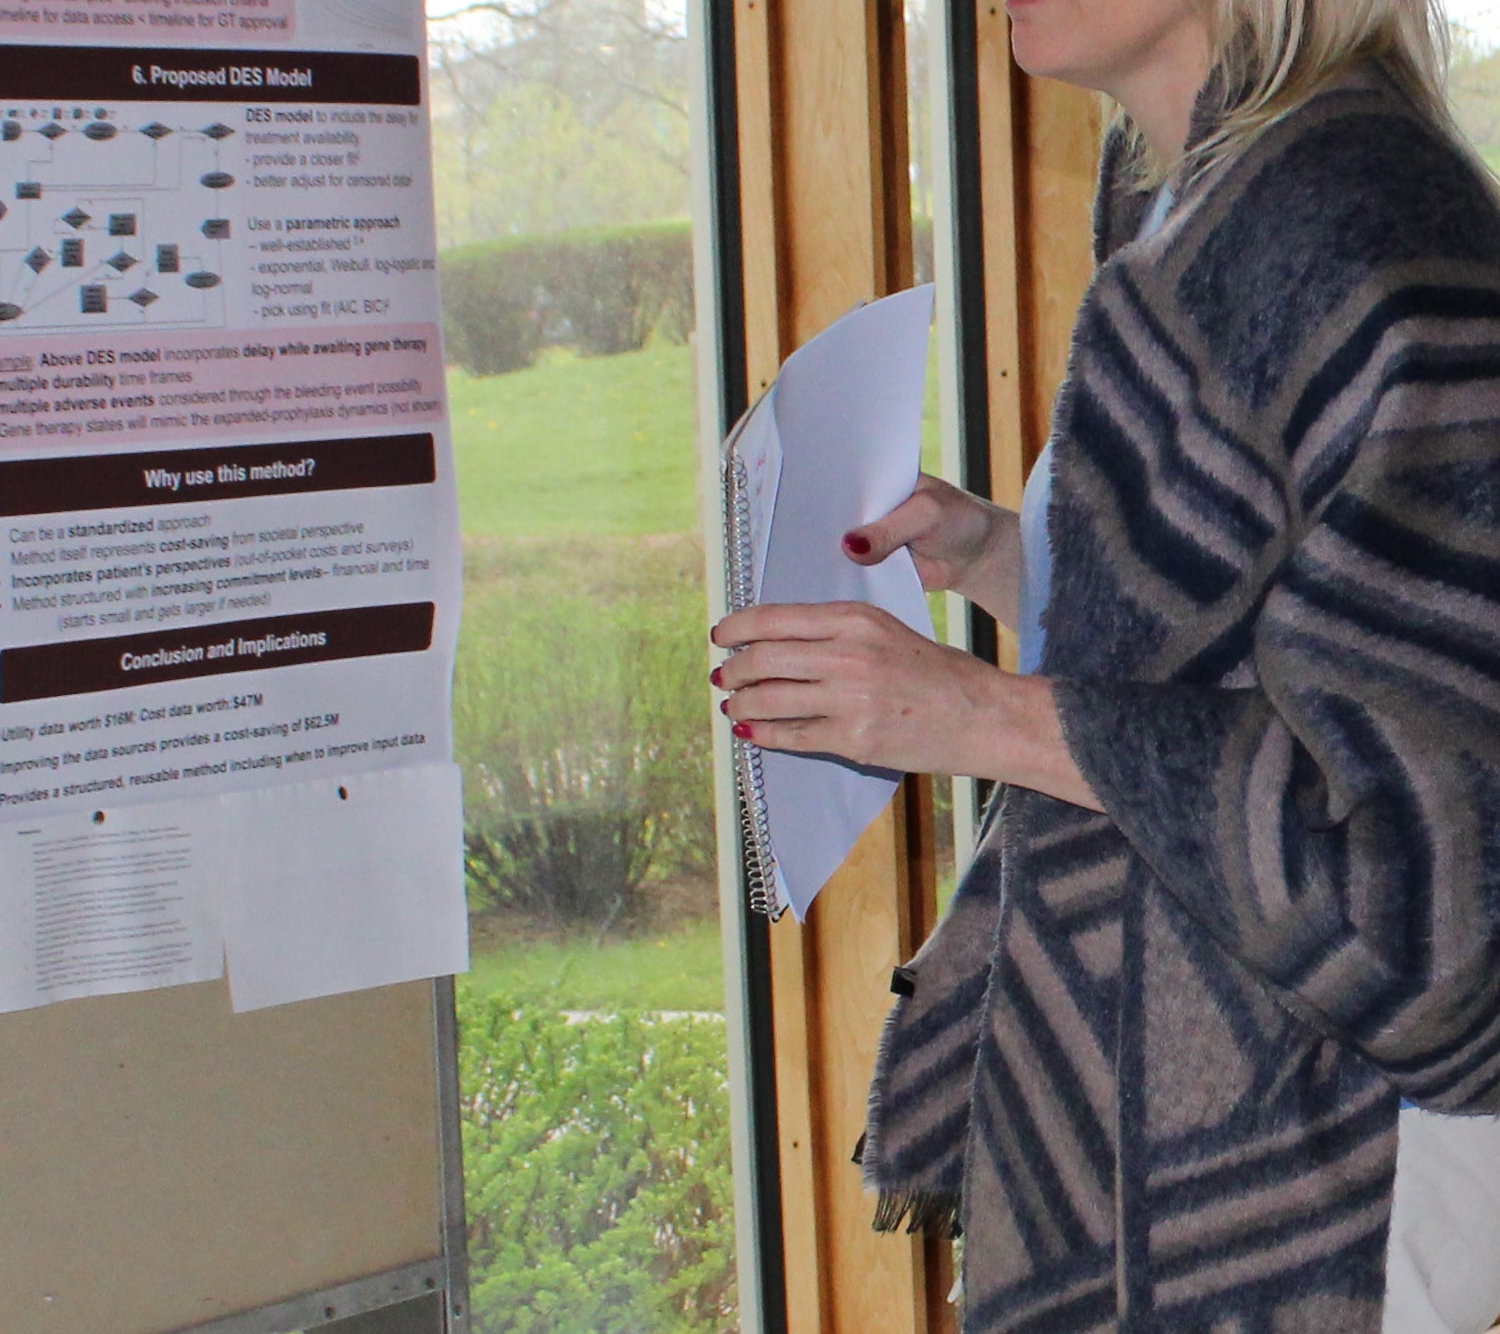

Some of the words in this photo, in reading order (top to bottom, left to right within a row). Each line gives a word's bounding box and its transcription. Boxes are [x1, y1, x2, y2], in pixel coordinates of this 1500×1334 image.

[131, 65, 147, 84] 6.
[149, 65, 226, 88] Proposed
[229, 66, 263, 86] DES
[265, 67, 312, 86] Model
[143, 467, 181, 493] Why
[184, 469, 214, 485] use
[216, 462, 246, 483] this
[249, 457, 315, 480] method?
[120, 642, 204, 671] Conclusion
[206, 638, 235, 659] and
[237, 627, 326, 659] Implications
